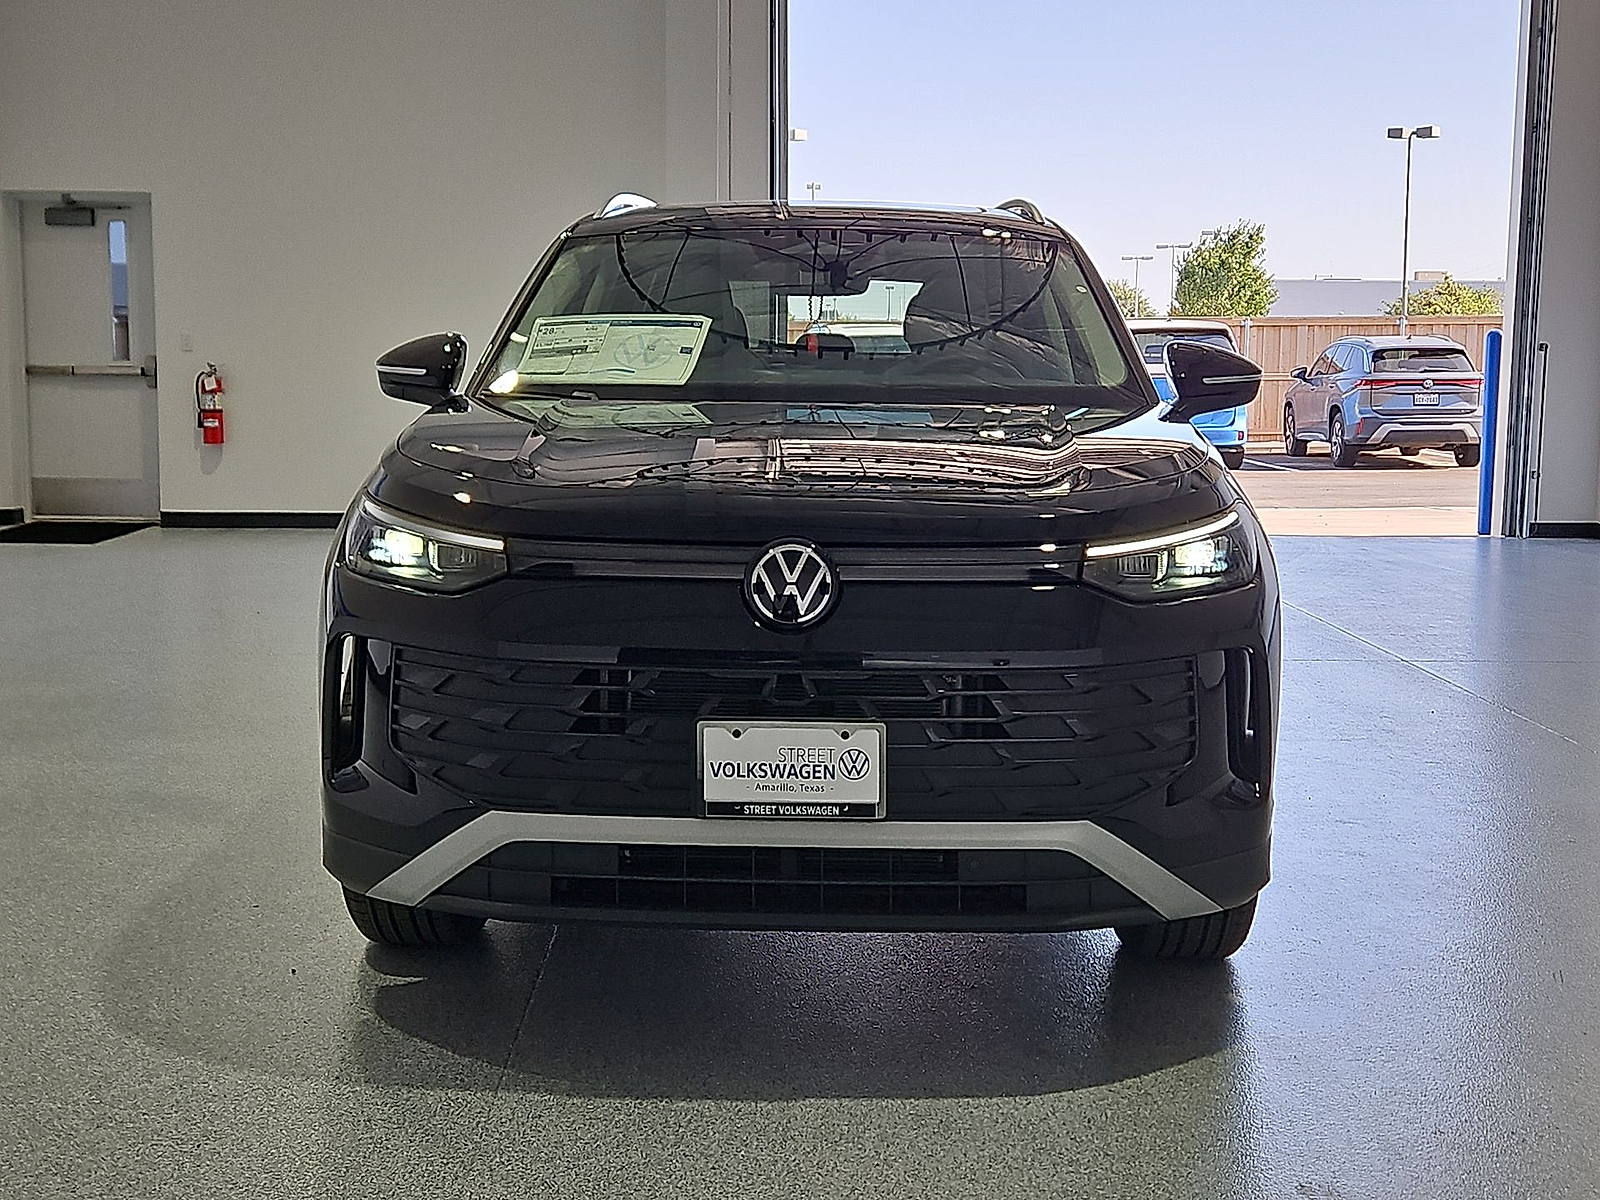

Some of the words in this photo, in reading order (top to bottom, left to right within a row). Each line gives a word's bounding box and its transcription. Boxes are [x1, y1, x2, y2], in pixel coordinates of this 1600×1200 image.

[778, 747, 836, 763] STREET
[709, 761, 836, 780] VOLKSWAGEN
[755, 782, 797, 793] Amarillo,
[799, 783, 825, 793] Texas
[743, 805, 777, 815] STREET
[778, 805, 840, 816] VOLKSWAGEN
